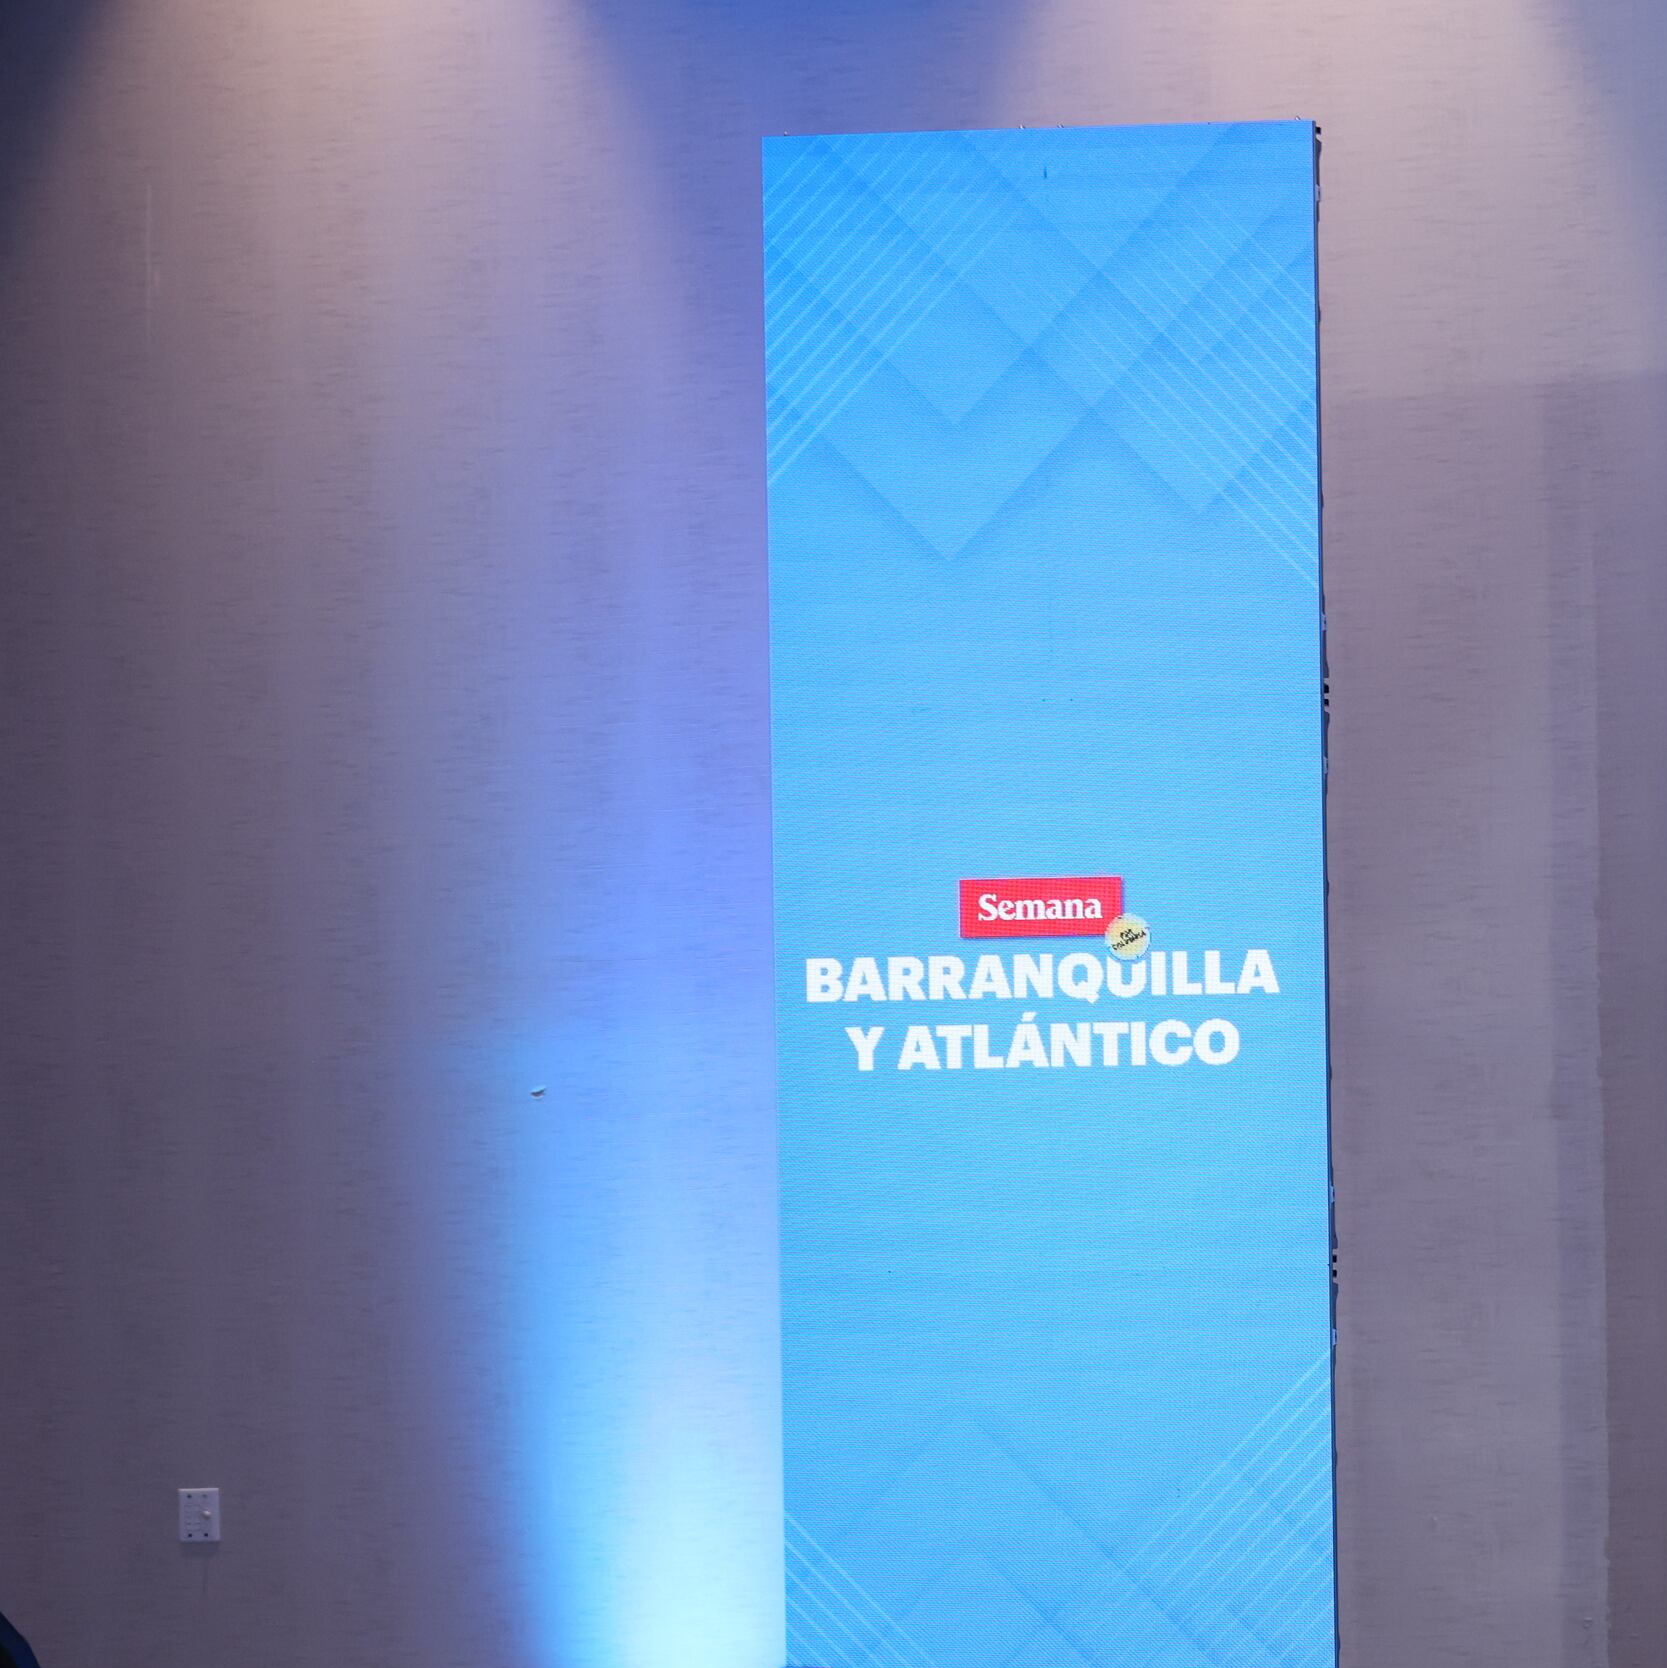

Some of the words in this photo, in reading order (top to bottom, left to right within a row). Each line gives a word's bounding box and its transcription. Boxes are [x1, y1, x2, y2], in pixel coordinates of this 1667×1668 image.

[977, 893, 1103, 922] Semana
[805, 949, 1280, 1003] BARRANQUILLA
[846, 1026, 883, 1071] Y
[897, 1012, 1240, 1071] ATLÁNTICO
